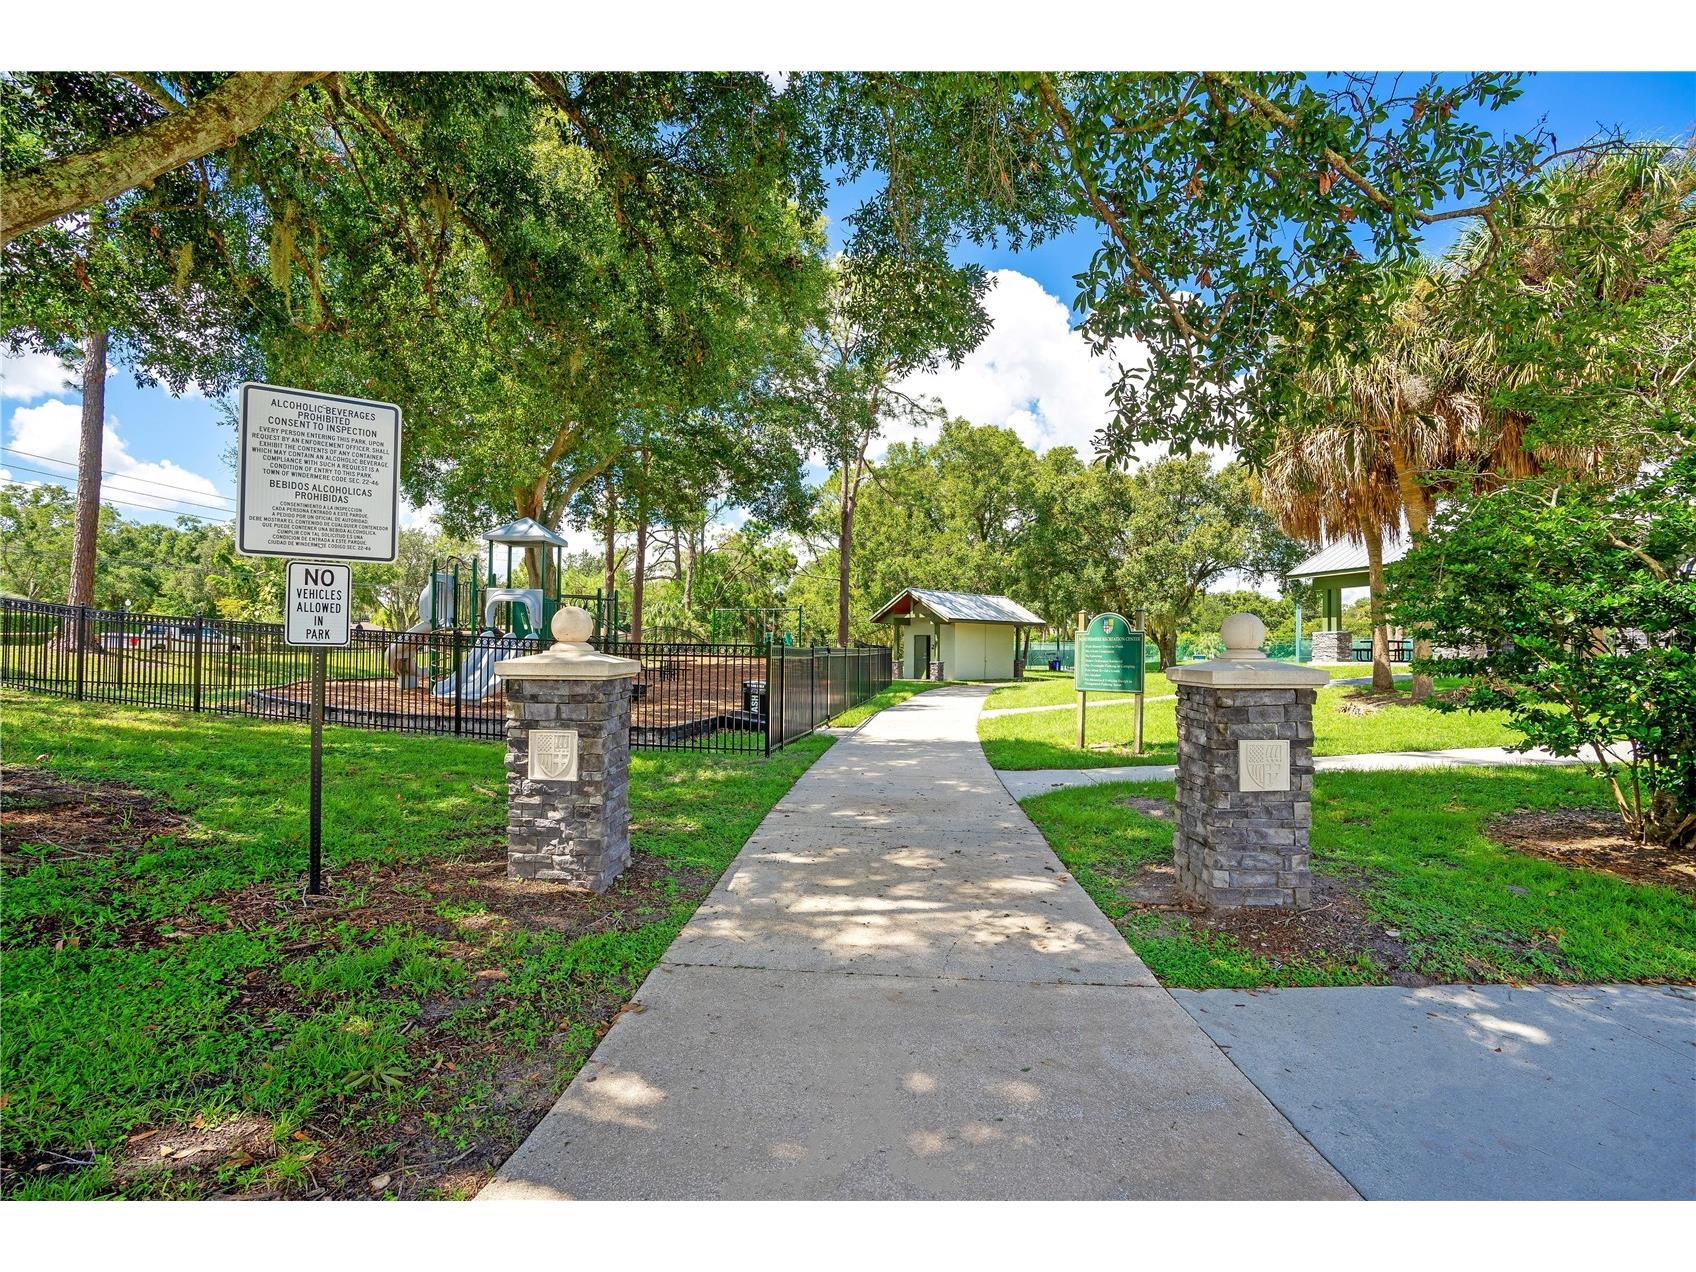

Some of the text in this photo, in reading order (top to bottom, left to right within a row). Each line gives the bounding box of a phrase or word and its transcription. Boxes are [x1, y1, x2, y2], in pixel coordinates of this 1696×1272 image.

[271, 399, 376, 421] ALCOHOLIC BEVERAGES
[298, 411, 350, 426] PROHIBITED
[259, 426, 279, 434] EVERY
[281, 429, 305, 437] PERSON
[307, 432, 335, 441] ENTERING
[268, 416, 377, 438] CONSENT TO INSPECTION
[252, 432, 280, 441] REQUEST
[301, 439, 344, 449] ENFORCEMENT
[259, 441, 283, 449] EXHIBIT
[297, 445, 328, 454] CONTENTS
[351, 452, 383, 461] CONTAINER
[288, 451, 314, 459] CONTAIN
[325, 455, 358, 464] ALCOHOLIC
[262, 455, 302, 464] COMPLIANCE
[270, 463, 303, 471] CONDITION
[291, 472, 330, 481] WINDERMERE
[269, 479, 372, 497] BEBIDOS ALCOHOLICAS
[295, 491, 349, 504] PROHIBIDAS
[280, 501, 322, 509] CONSENTIMIENTO
[304, 568, 334, 586] NO
[297, 588, 342, 601] VEHICLES
[296, 602, 341, 613] ALLOWED
[314, 616, 323, 626] IN
[306, 629, 330, 640] PARK
[751, 695, 759, 714] ASH
